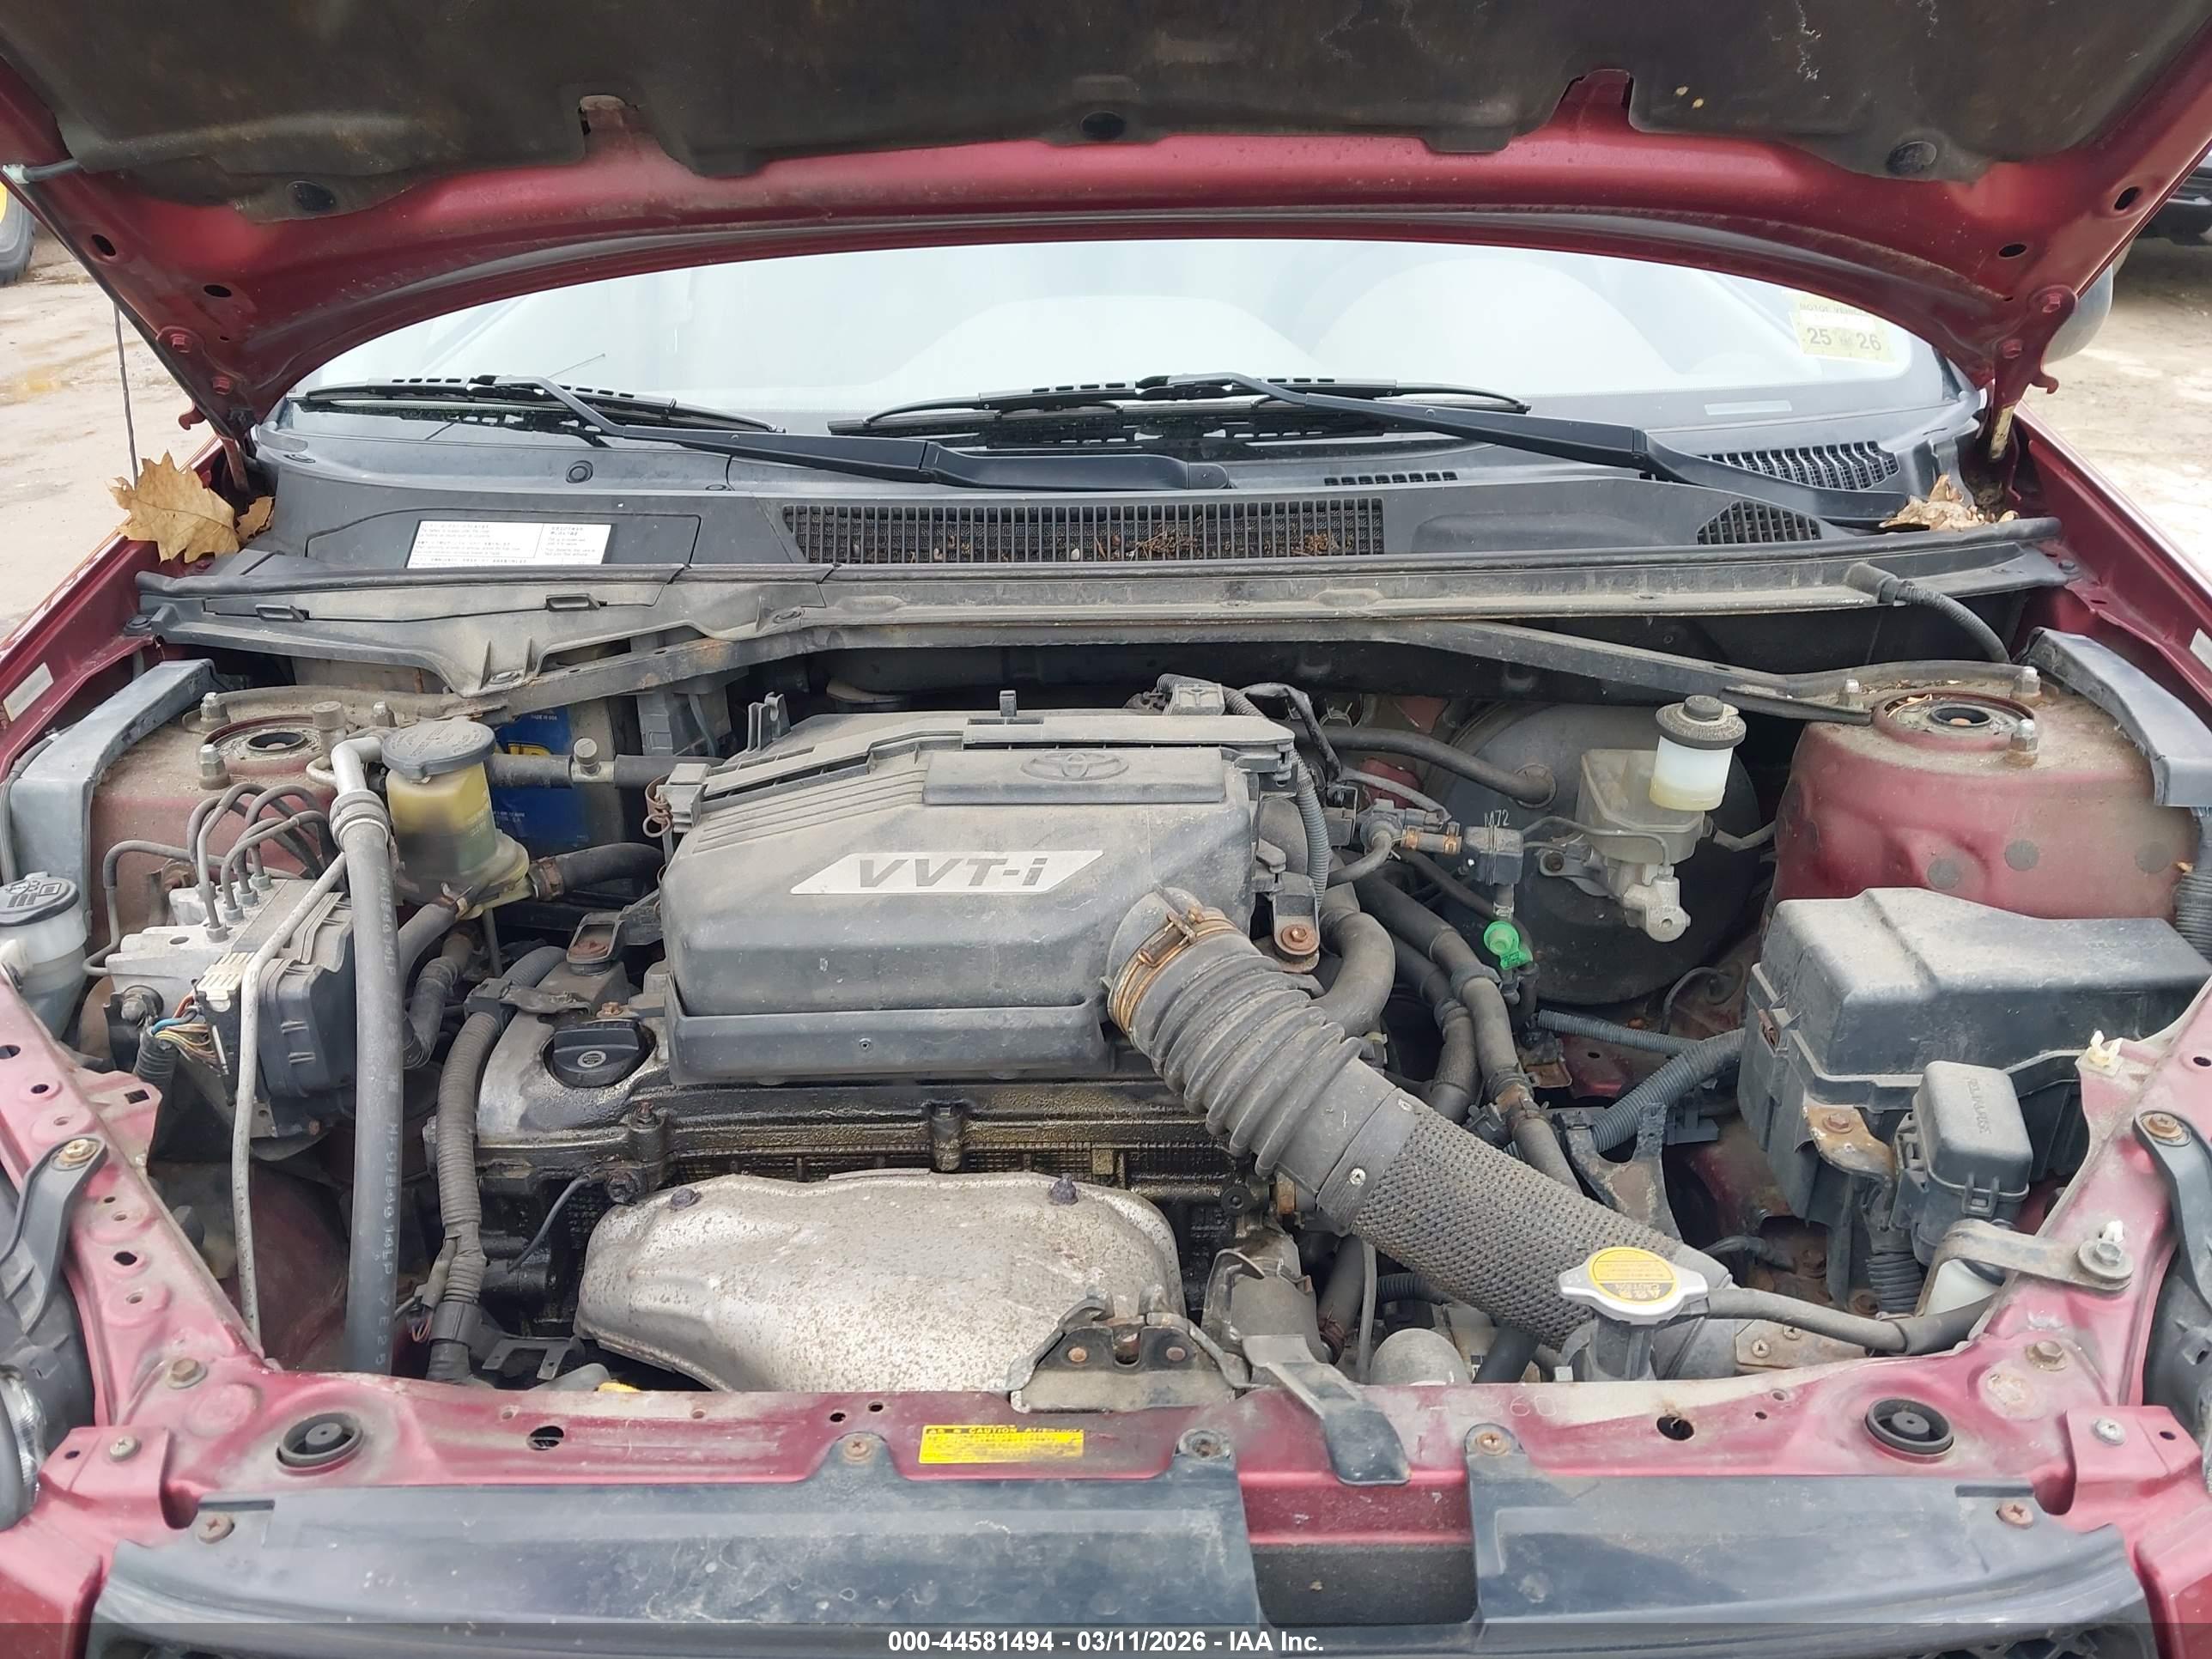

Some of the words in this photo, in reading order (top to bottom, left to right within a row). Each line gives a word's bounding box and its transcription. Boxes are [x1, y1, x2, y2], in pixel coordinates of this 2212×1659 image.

[1807, 327, 1832, 346] 25
[1856, 332, 1882, 351] 26
[859, 857, 1049, 888] VVT-i
